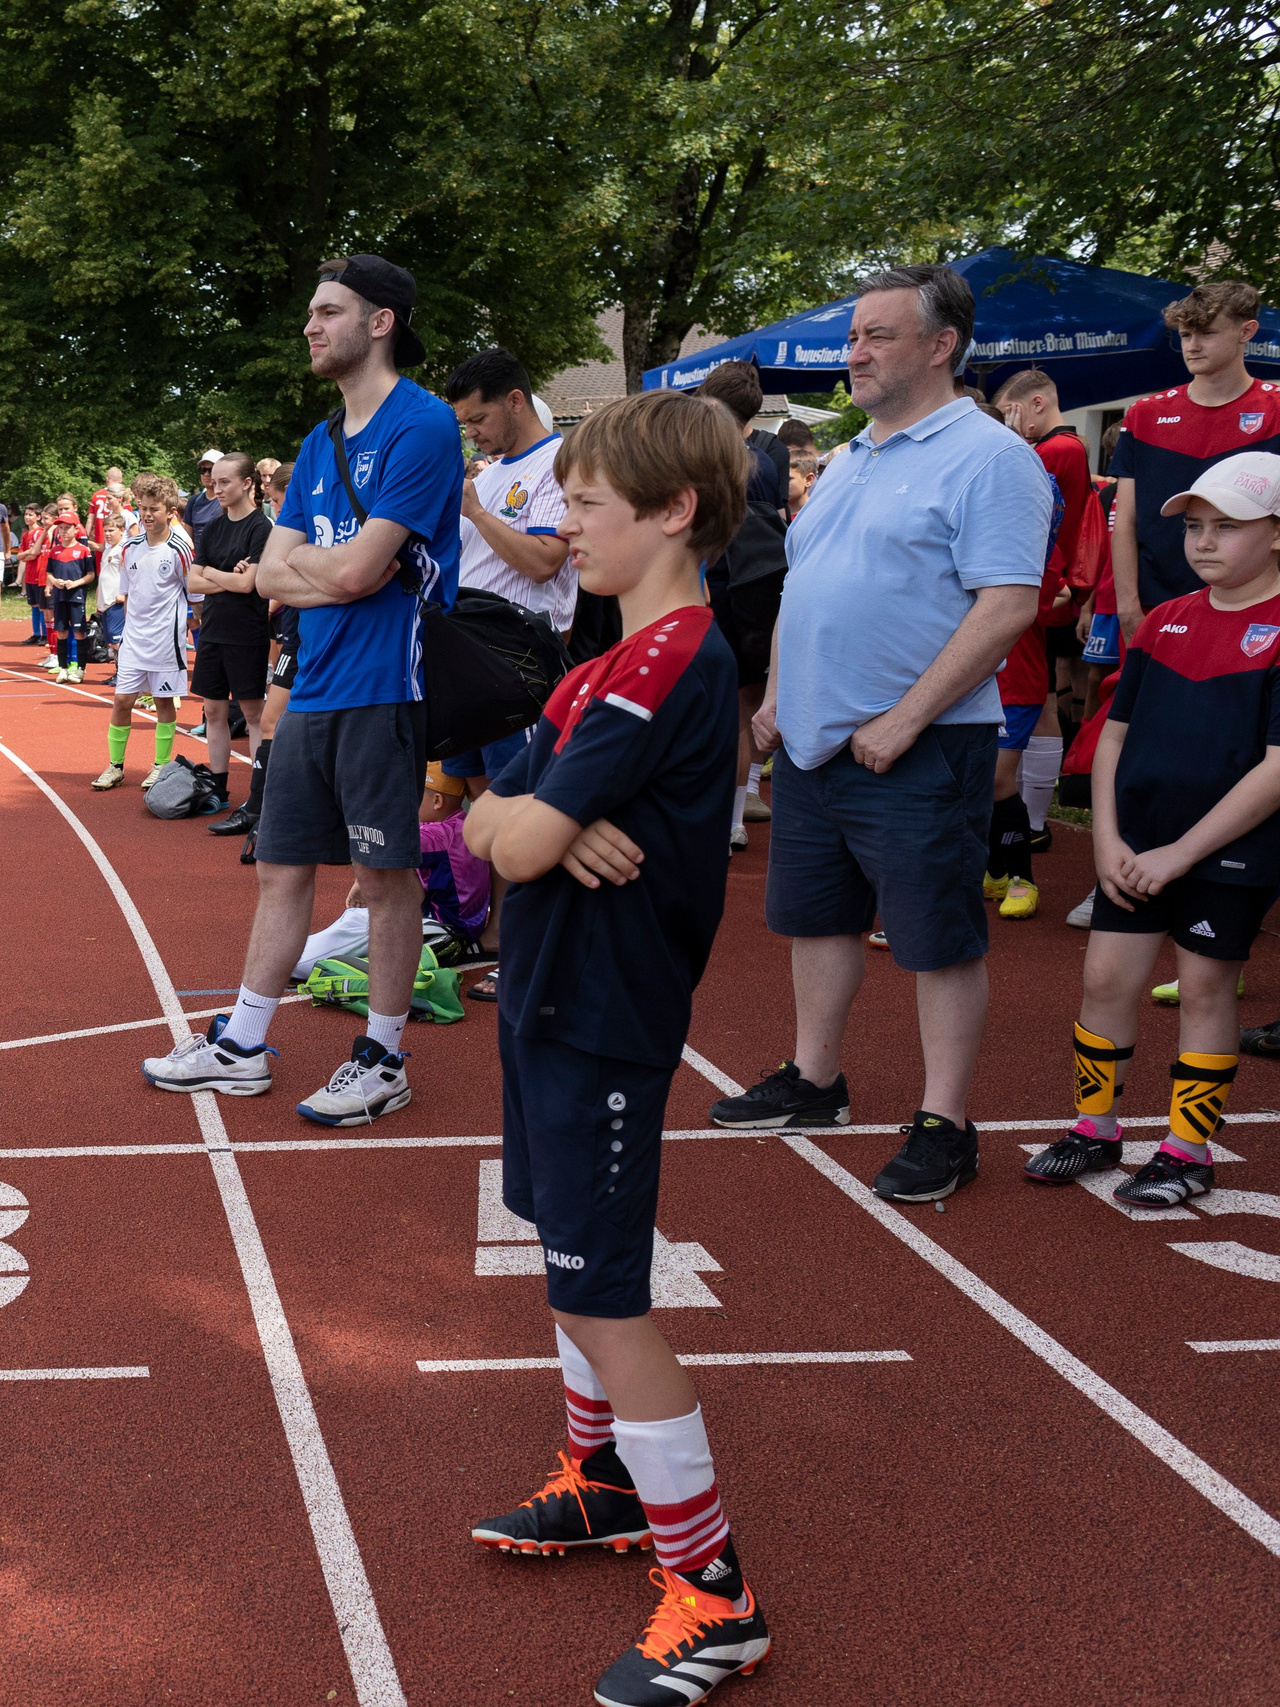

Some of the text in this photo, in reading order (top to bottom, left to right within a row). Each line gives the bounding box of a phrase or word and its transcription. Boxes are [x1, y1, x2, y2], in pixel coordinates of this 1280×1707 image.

[1076, 330, 1128, 350] München
[1156, 415, 1182, 425] JAKO
[1249, 634, 1267, 643] SVU
[1189, 926, 1216, 938] adidas
[546, 1248, 586, 1270] JAKO
[700, 1566, 733, 1581] adidas
